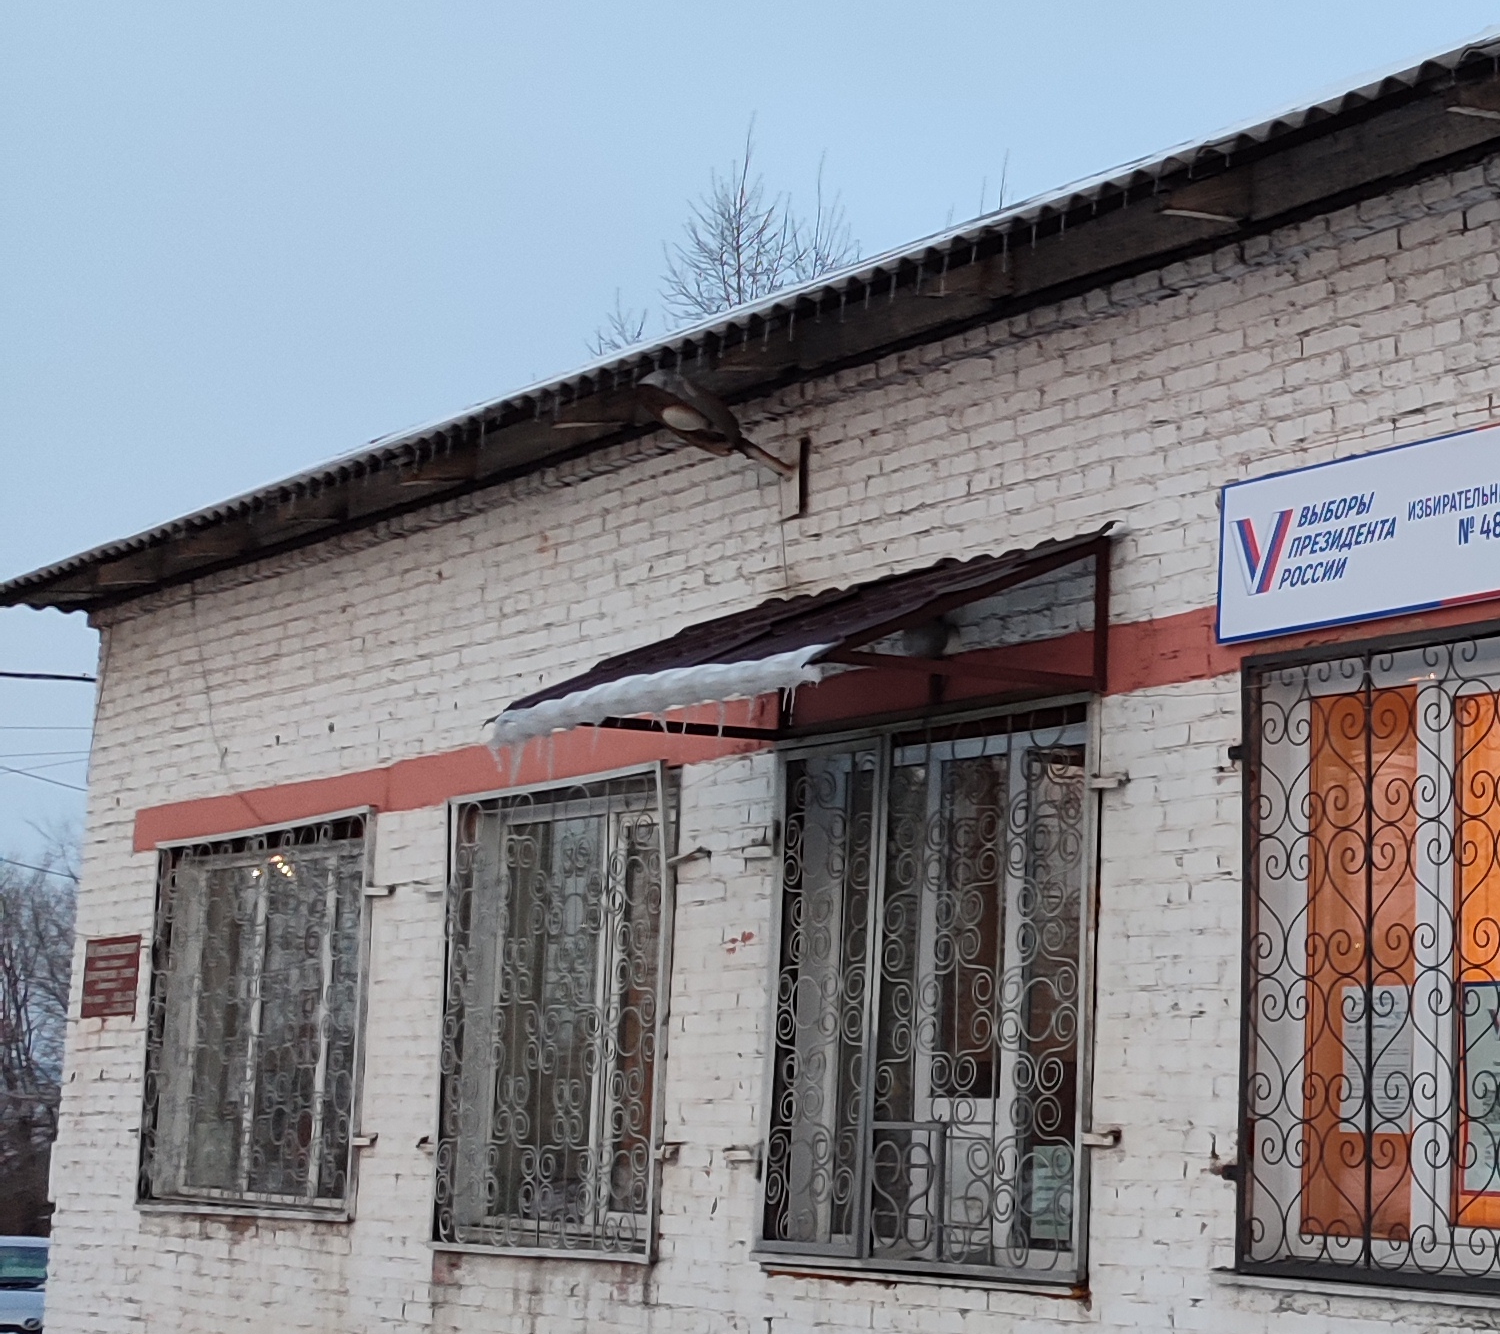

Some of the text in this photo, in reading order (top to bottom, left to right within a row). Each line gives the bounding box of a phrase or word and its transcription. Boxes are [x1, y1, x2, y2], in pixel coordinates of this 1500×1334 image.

[1297, 491, 1375, 528] ВЫБОРЫ
[1287, 516, 1397, 559] ПРЕЗИДЕНТА
[1457, 515, 1476, 546] №
[1278, 556, 1348, 590] РОССИИ
